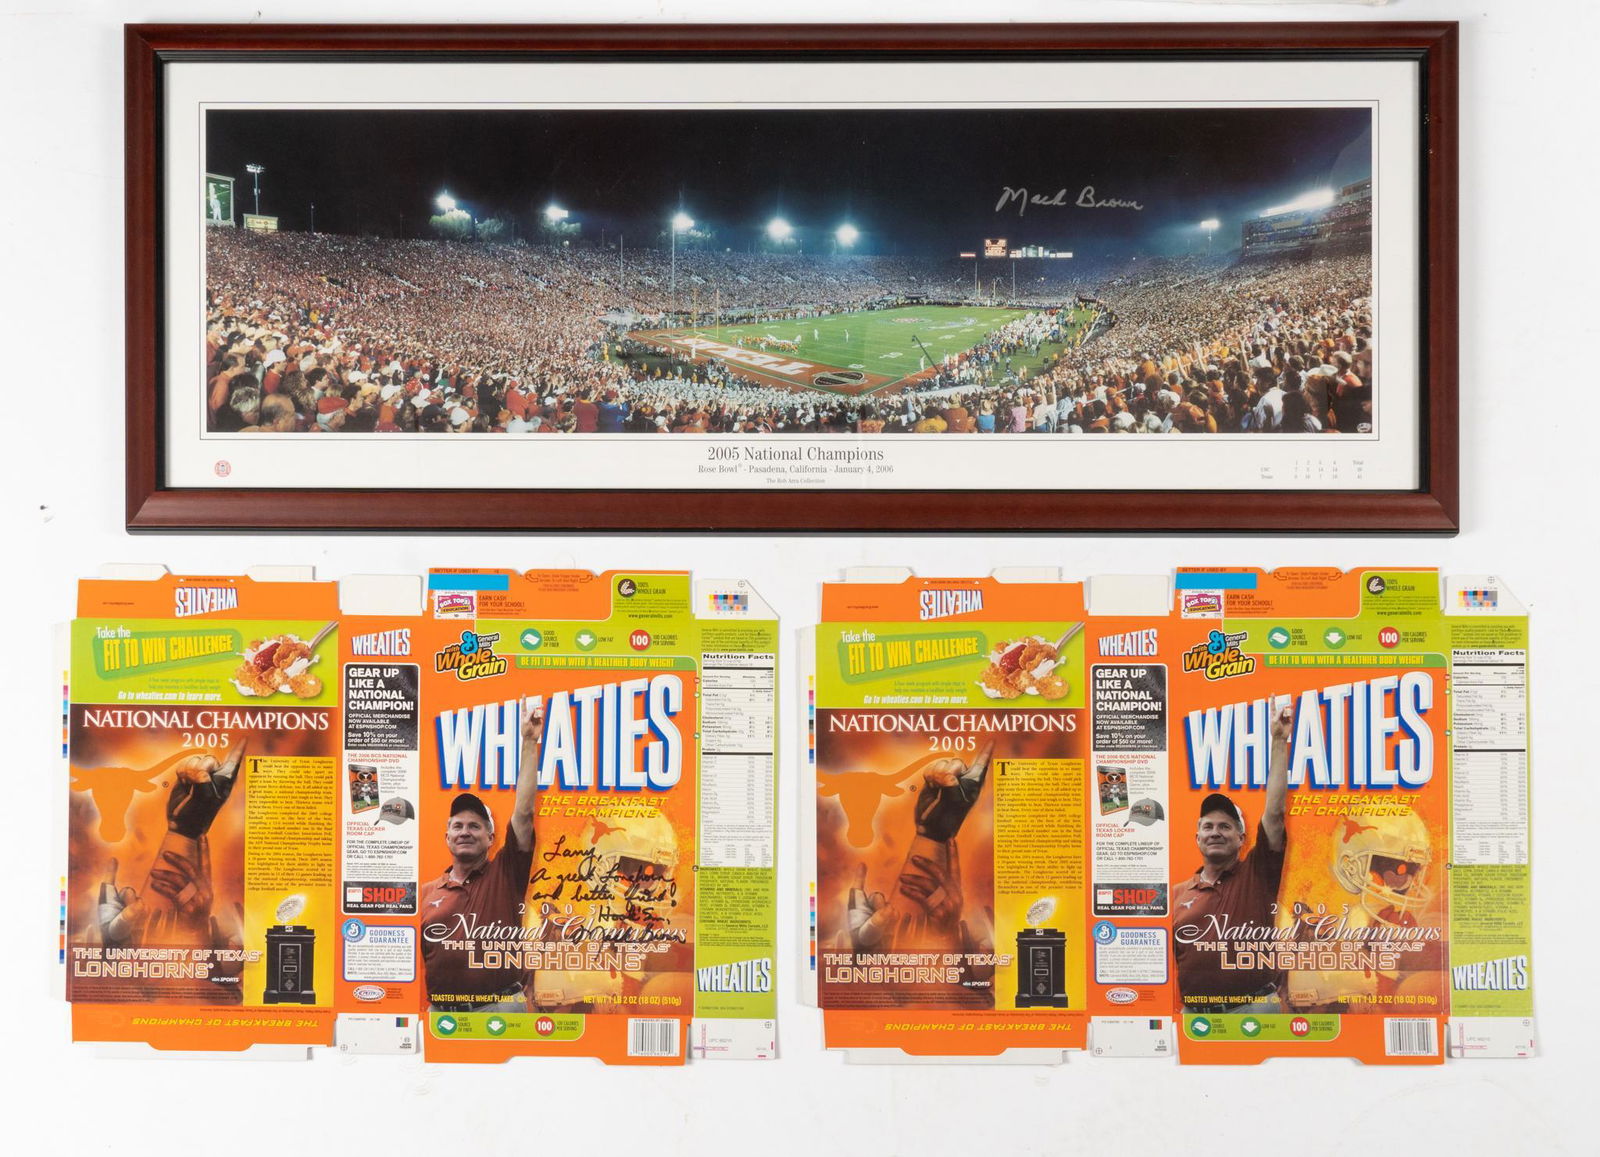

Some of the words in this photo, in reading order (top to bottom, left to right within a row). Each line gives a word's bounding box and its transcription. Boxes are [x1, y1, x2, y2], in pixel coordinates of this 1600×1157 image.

[1075, 186, 1144, 211] Brown
[707, 447, 740, 461] 2005
[744, 446, 802, 461] National
[807, 447, 884, 463] Champions
[698, 465, 717, 473] Rose
[749, 465, 788, 474] Pasadena,
[789, 464, 827, 473] California
[834, 465, 865, 474] January
[866, 465, 874, 474] 4,
[875, 465, 894, 473] 2006
[175, 587, 238, 617] WHEATIES
[919, 589, 984, 621] WHEATIES
[96, 627, 116, 639] Take
[117, 626, 131, 638] the
[841, 631, 860, 643] Take
[862, 629, 875, 642] the
[1381, 633, 1397, 643] 100
[351, 628, 411, 656] WHEATIES
[632, 635, 648, 646] 100
[1098, 628, 1158, 656] WHEATIES
[103, 639, 121, 672] FIT
[124, 638, 139, 668] TO
[142, 637, 167, 665] WIN
[169, 634, 233, 660] CHALLENGE
[848, 643, 866, 675] FIT
[868, 642, 884, 671] TO
[887, 640, 912, 669] WIN
[914, 636, 978, 664] CHALLENGE
[436, 650, 491, 672] Whole
[568, 657, 585, 666] WITH
[594, 657, 628, 667] HEALTHIER
[649, 658, 675, 668] WEIGHT
[1184, 649, 1239, 672] Whole
[349, 668, 380, 678] GEAR
[383, 668, 400, 678] UP
[458, 659, 507, 679] Grain
[1096, 669, 1128, 679] GEAR
[1130, 669, 1147, 679] UP
[1207, 658, 1256, 679] Grain
[349, 679, 374, 689] LIKE
[376, 679, 385, 689] A
[1096, 680, 1122, 690] LIKE
[1123, 680, 1133, 690] A
[135, 691, 178, 701] wheaties.com
[186, 692, 203, 701] learn
[204, 693, 222, 701] more.
[349, 690, 405, 700] NATIONAL
[1096, 690, 1153, 700] NATIONAL
[349, 701, 414, 711] CHAMPION!
[1096, 702, 1162, 712] CHAMPION!
[83, 709, 193, 730] NATIONAL
[196, 711, 329, 731] CHAMPIONS
[829, 714, 940, 732] NATIONAL
[943, 714, 1076, 732] CHAMPIONS
[182, 734, 229, 748] 2005
[928, 736, 976, 751] 2005
[540, 795, 572, 805] THE
[577, 796, 668, 806] BREAKFAST
[538, 807, 560, 817] OF
[363, 887, 407, 903] SHOP
[532, 888, 561, 901] and
[570, 883, 615, 901] better
[1113, 888, 1158, 904] SHOP
[369, 929, 406, 937] GOODNESS
[423, 913, 548, 942] National
[554, 915, 687, 942] Champions
[1174, 913, 1301, 943] National
[1304, 915, 1442, 942] Champions
[1120, 931, 1157, 939] GOODNESS
[441, 940, 476, 951] THE
[481, 940, 583, 951] UNIVERSITY
[587, 941, 611, 951] OF
[1193, 941, 1228, 952] THE
[1234, 941, 1335, 952] UNIVERSITY
[1340, 941, 1364, 952] OF
[72, 947, 102, 960] THE
[106, 948, 188, 961] UNIVERSITY
[192, 949, 212, 961] OF
[823, 953, 853, 965] THE
[856, 953, 939, 966] UNIVERSITY
[942, 953, 962, 966] OF
[697, 957, 771, 993] WHEATIES
[1452, 955, 1528, 991] WHEATIES
[431, 994, 455, 1002] TOASTED
[455, 994, 475, 1002] WHOLE
[475, 994, 494, 1002] WHEAT
[494, 994, 514, 1002] FLAKES
[131, 1017, 201, 1026] CHAMPIONS
[204, 1018, 221, 1026] OF
[223, 1018, 292, 1027] BREAKFAST
